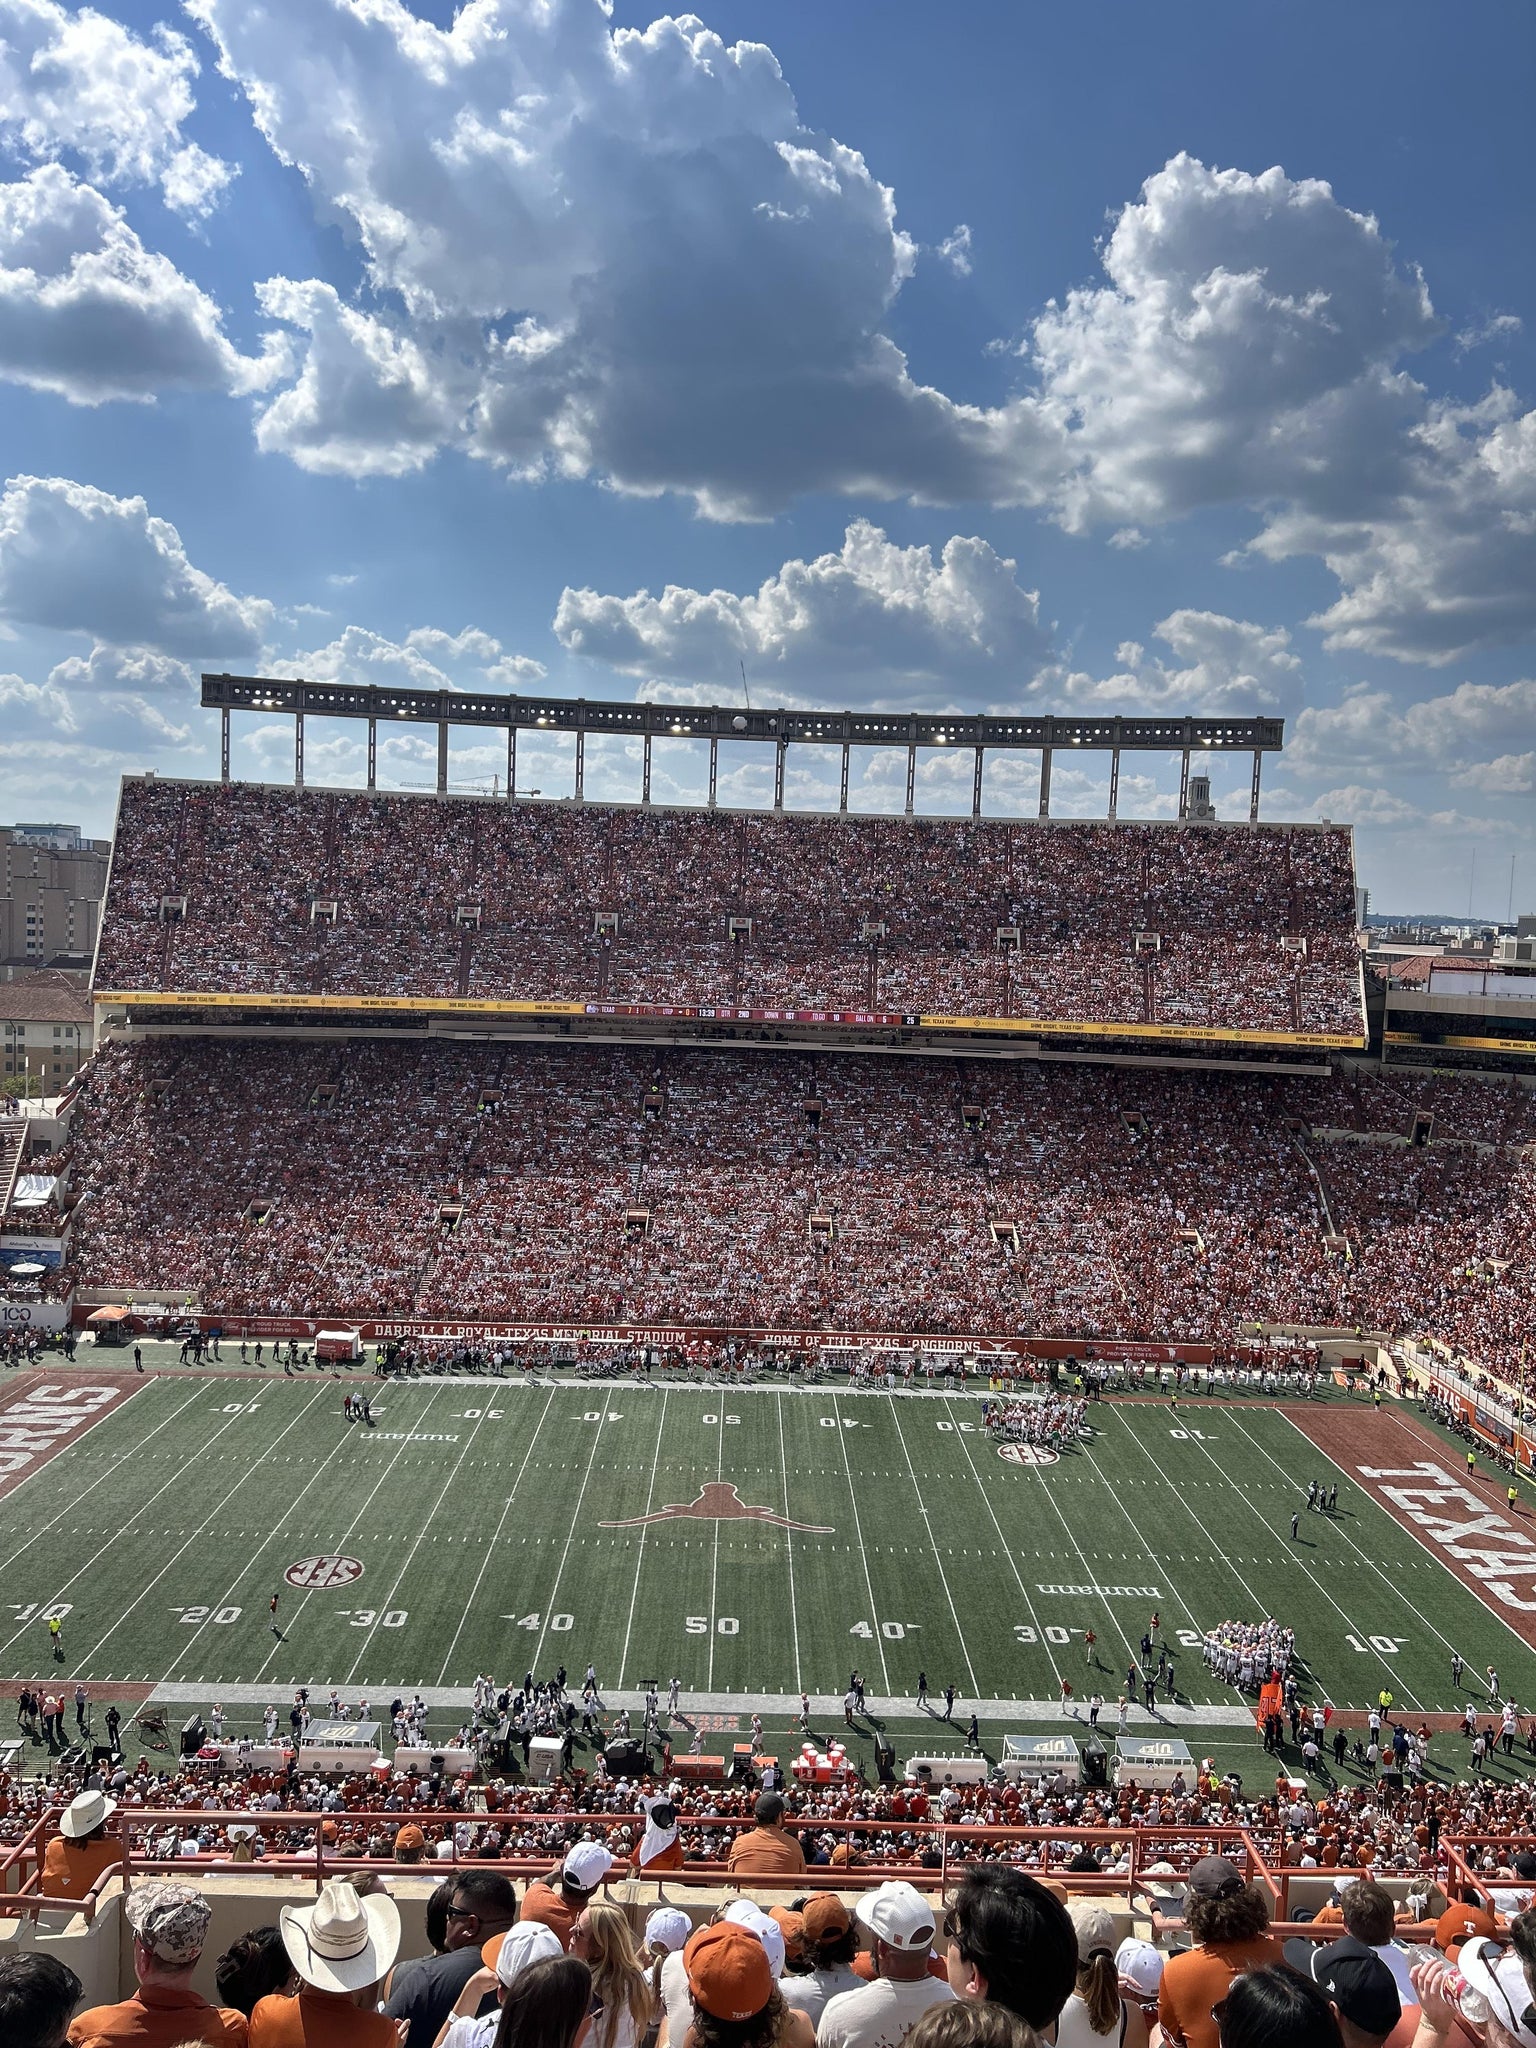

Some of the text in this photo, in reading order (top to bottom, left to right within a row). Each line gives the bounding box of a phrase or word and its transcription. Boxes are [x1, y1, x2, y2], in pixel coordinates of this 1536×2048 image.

[699, 1009, 715, 1017] 13:39
[785, 1012, 795, 1020] 1ST
[833, 1013, 840, 1021] 10
[906, 1017, 915, 1025] 25
[2, 1307, 31, 1321] 100
[457, 1327, 548, 1339] ROYAL-TEXAS
[553, 1329, 621, 1340] MEMRIAL
[627, 1331, 686, 1343] STADIUM
[765, 1334, 981, 1351] HOME OF THE TEXAS ONGHORNS
[222, 1403, 261, 1413] 10
[462, 1409, 506, 1419] 30
[583, 1411, 625, 1422] 40
[702, 1414, 742, 1425] 50
[819, 1417, 860, 1428] 40
[935, 1421, 975, 1432] 30
[359, 1432, 461, 1443] humann
[1168, 1429, 1207, 1440] 10
[1000, 1443, 1058, 1465] SEC
[289, 1557, 358, 1587] SEC
[1035, 1584, 1165, 1600] humann
[14, 1603, 74, 1620] 10
[178, 1606, 243, 1624] 20
[349, 1610, 409, 1628] 30
[516, 1613, 575, 1631] 40
[685, 1616, 740, 1635] 50
[849, 1621, 906, 1639] 40
[1013, 1625, 1071, 1644] 30
[1175, 1629, 1204, 1647] 2
[1345, 1634, 1400, 1654] 10
[1464, 1920, 1476, 1934] T
[731, 2010, 753, 2019] TEXAS
